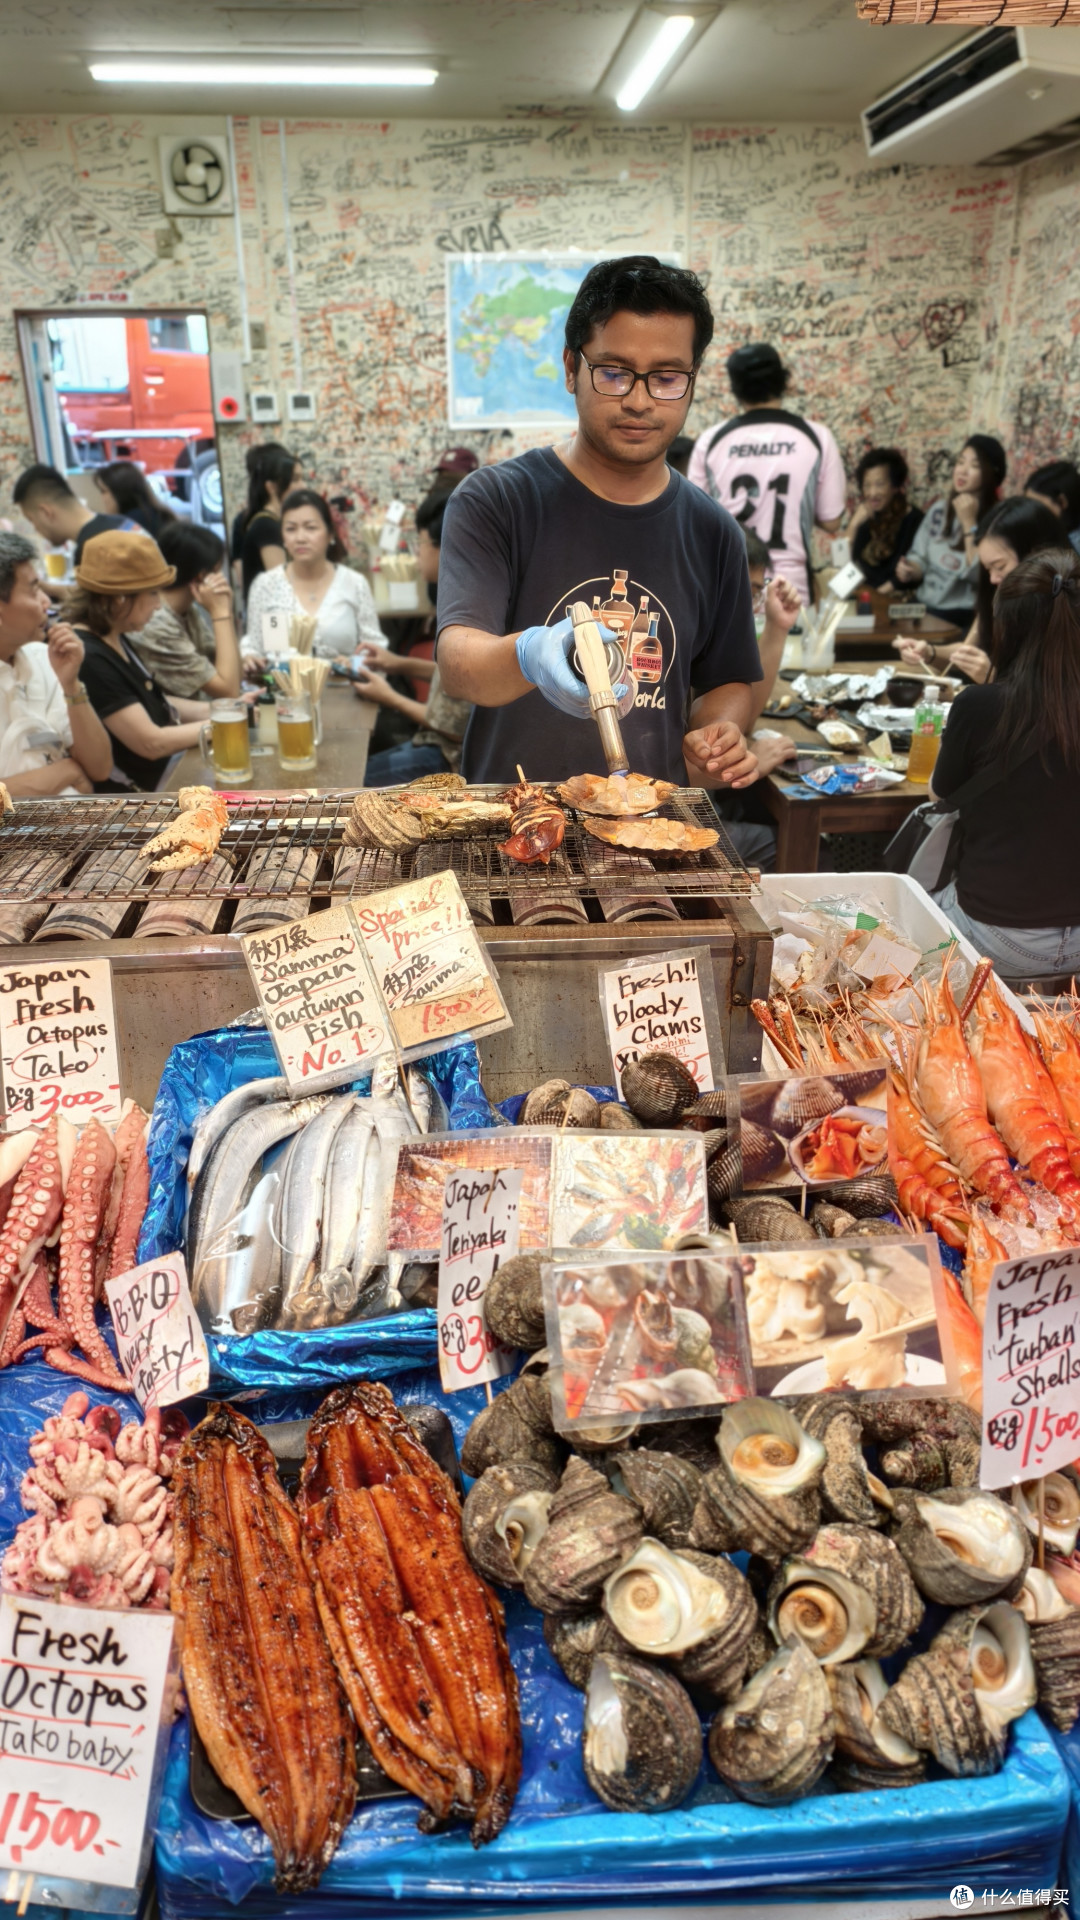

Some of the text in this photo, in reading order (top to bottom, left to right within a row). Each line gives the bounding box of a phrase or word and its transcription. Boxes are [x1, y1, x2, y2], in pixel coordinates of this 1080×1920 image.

[728, 442, 797, 458] PENALTY
[730, 473, 790, 551] 21
[270, 616, 278, 629] 5
[635, 686, 666, 710] orld
[359, 880, 444, 943] Special
[248, 924, 317, 963] 秋刀魚
[0, 968, 91, 1000] Japan
[264, 963, 356, 1005] Japan
[618, 959, 698, 999] Fresh!!
[16, 986, 95, 1026] Fresh
[304, 1007, 364, 1045] Fish
[613, 992, 684, 1027] bloody
[27, 1023, 108, 1052] Octopus
[6, 1086, 35, 1111] Big
[446, 1178, 507, 1220] Japan
[452, 1253, 499, 1307] eel
[997, 1252, 1080, 1295] Japa
[998, 1274, 1073, 1340] Fresh
[441, 1318, 466, 1353] Big
[1011, 1347, 1080, 1406] Shells
[988, 1414, 1019, 1451] Big
[11, 1610, 128, 1667] Fresh
[1, 1663, 148, 1727] Octopas
[0, 1719, 134, 1777] Tako baby
